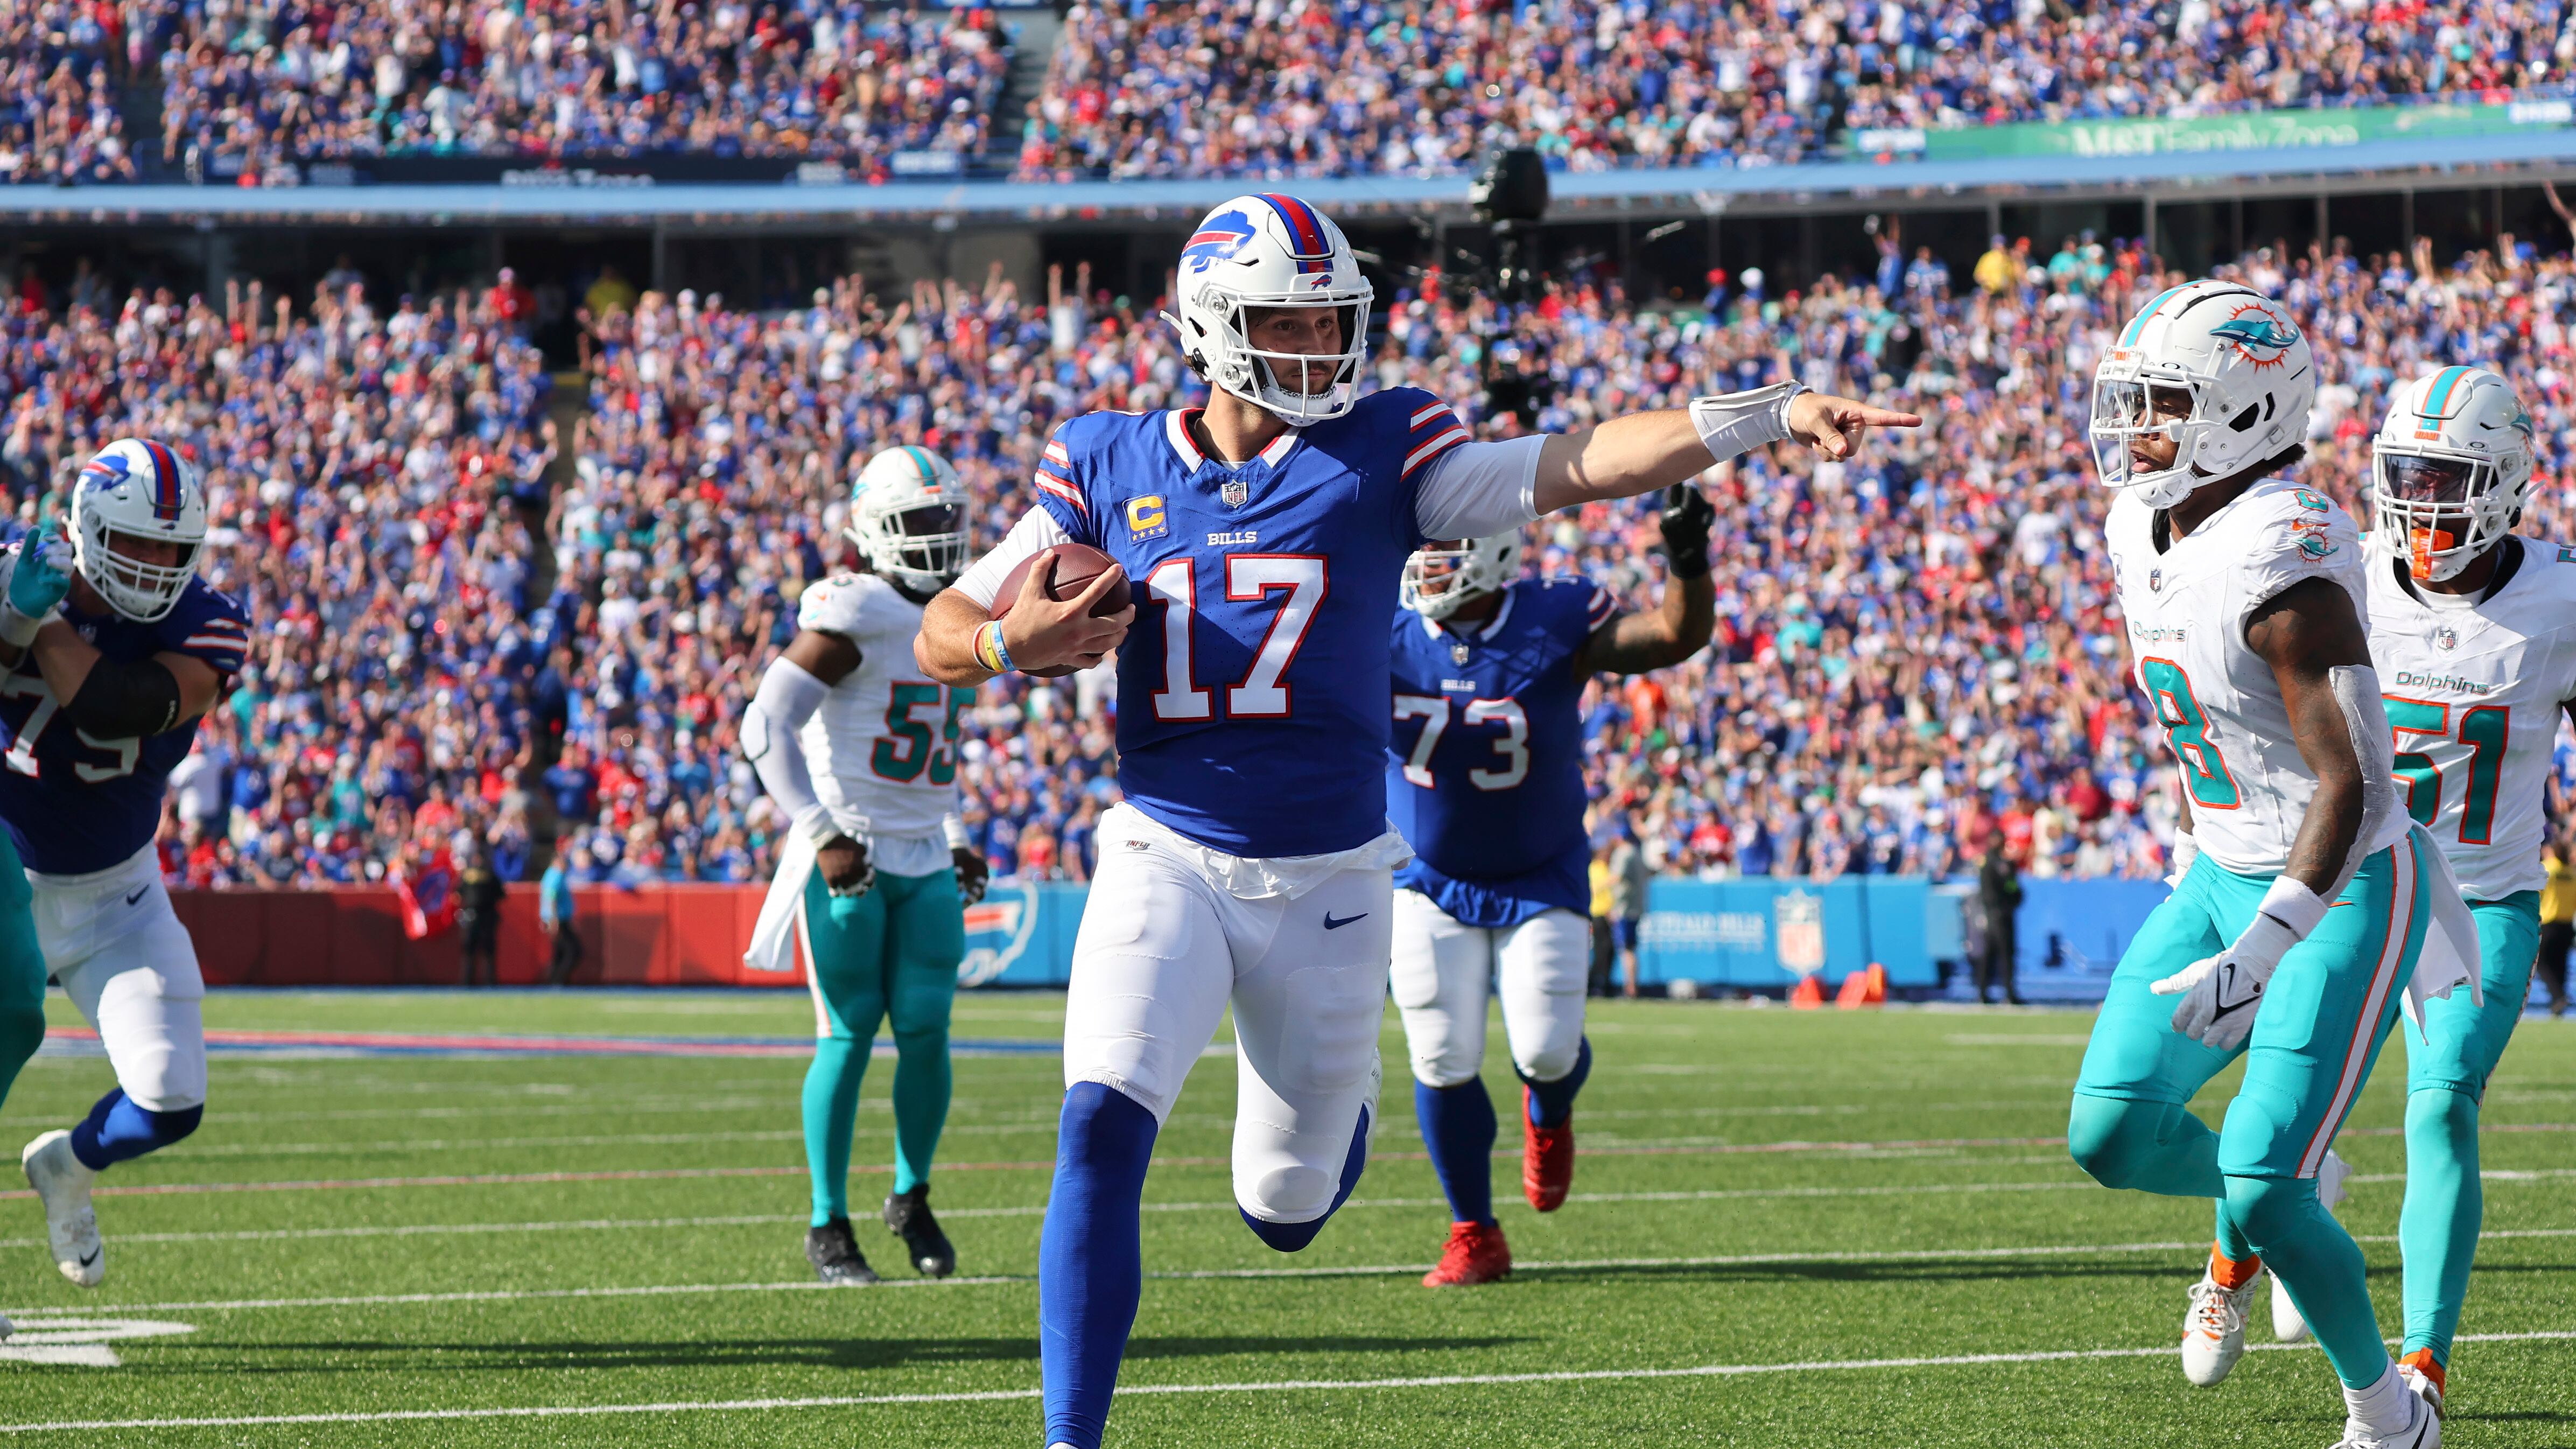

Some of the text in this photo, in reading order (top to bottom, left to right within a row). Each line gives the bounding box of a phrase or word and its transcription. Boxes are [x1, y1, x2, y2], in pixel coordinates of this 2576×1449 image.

[1127, 495, 1164, 531] C
[1207, 531, 1258, 546] BILLS
[1227, 491, 1243, 502] NFL
[1145, 553, 1329, 723] 17
[2396, 671, 2490, 696] Dolphins
[869, 680, 977, 786] 55
[1392, 695, 1531, 791] 73
[2140, 655, 2241, 810] 8
[2382, 694, 2510, 845] 51
